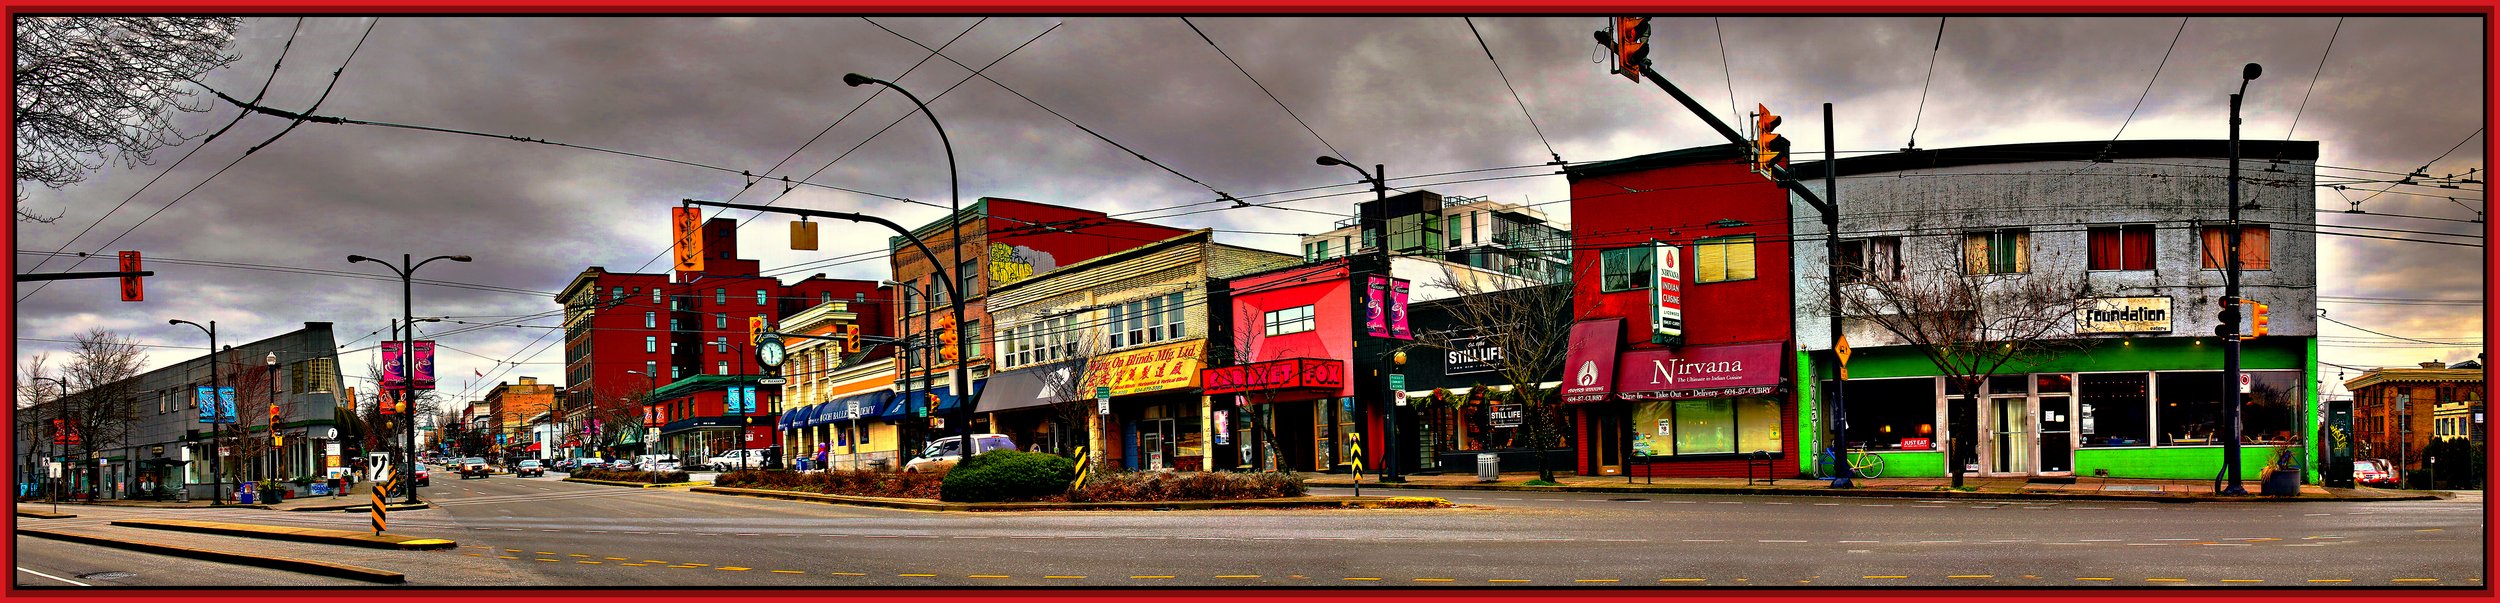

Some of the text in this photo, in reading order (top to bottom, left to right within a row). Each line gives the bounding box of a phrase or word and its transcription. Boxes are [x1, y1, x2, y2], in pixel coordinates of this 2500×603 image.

[1661, 268, 1679, 279] NIRVANA
[1662, 282, 1680, 292] INDIAN
[1662, 293, 1680, 305] CUISINE
[1112, 357, 1124, 369] On
[1125, 352, 1154, 367] Blinds
[1155, 348, 1175, 362] Mfg.
[1177, 344, 1196, 359] Ltd.
[1449, 348, 1478, 364] STILL
[1305, 363, 1341, 384] FOX
[1650, 359, 1743, 385] Nirvana
[1622, 392, 1637, 400] Dine
[1655, 391, 1670, 399] Take
[1693, 389, 1718, 398] Delivery
[822, 405, 876, 421] GOH BALLE DEMY
